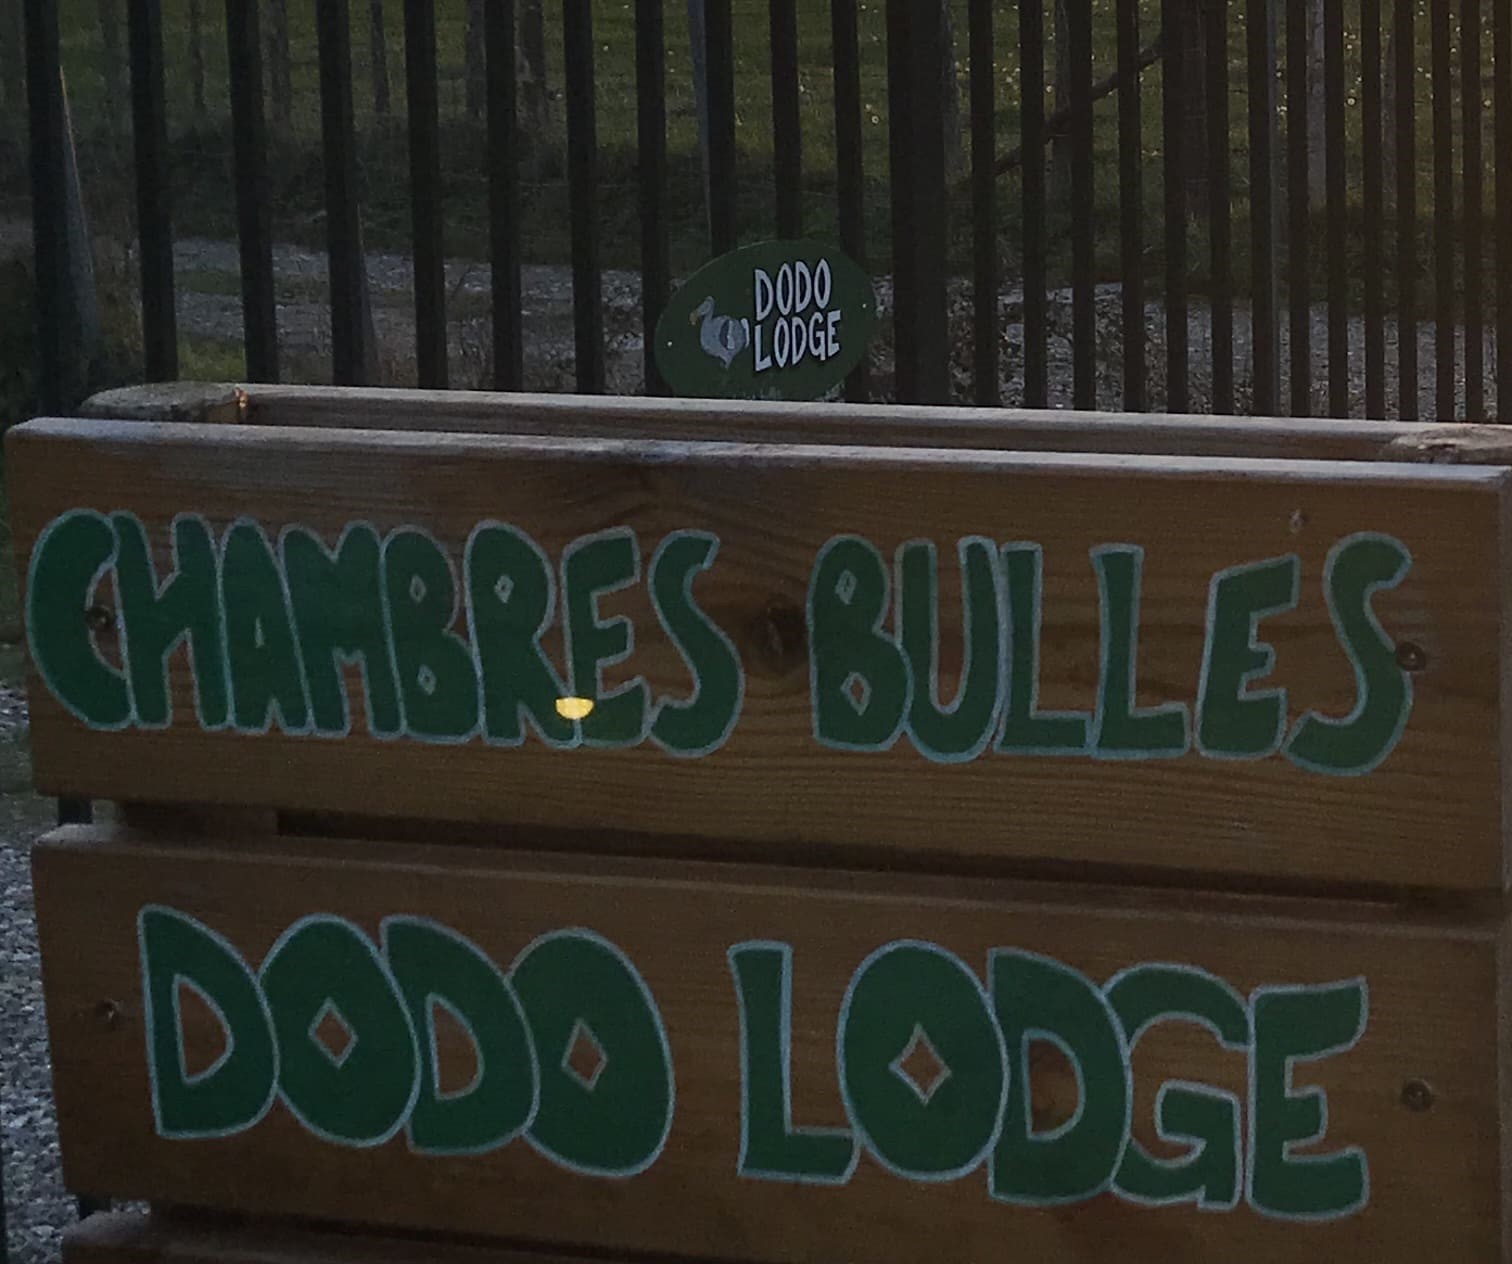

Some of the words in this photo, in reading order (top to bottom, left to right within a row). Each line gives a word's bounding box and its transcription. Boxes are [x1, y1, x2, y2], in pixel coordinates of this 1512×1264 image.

[754, 258, 832, 321] DODO
[754, 309, 842, 372] LODGE
[25, 508, 745, 757] CHAMBRES
[805, 532, 1413, 776] BULLES
[136, 904, 676, 1178] DODO
[727, 938, 1370, 1223] LODGE
